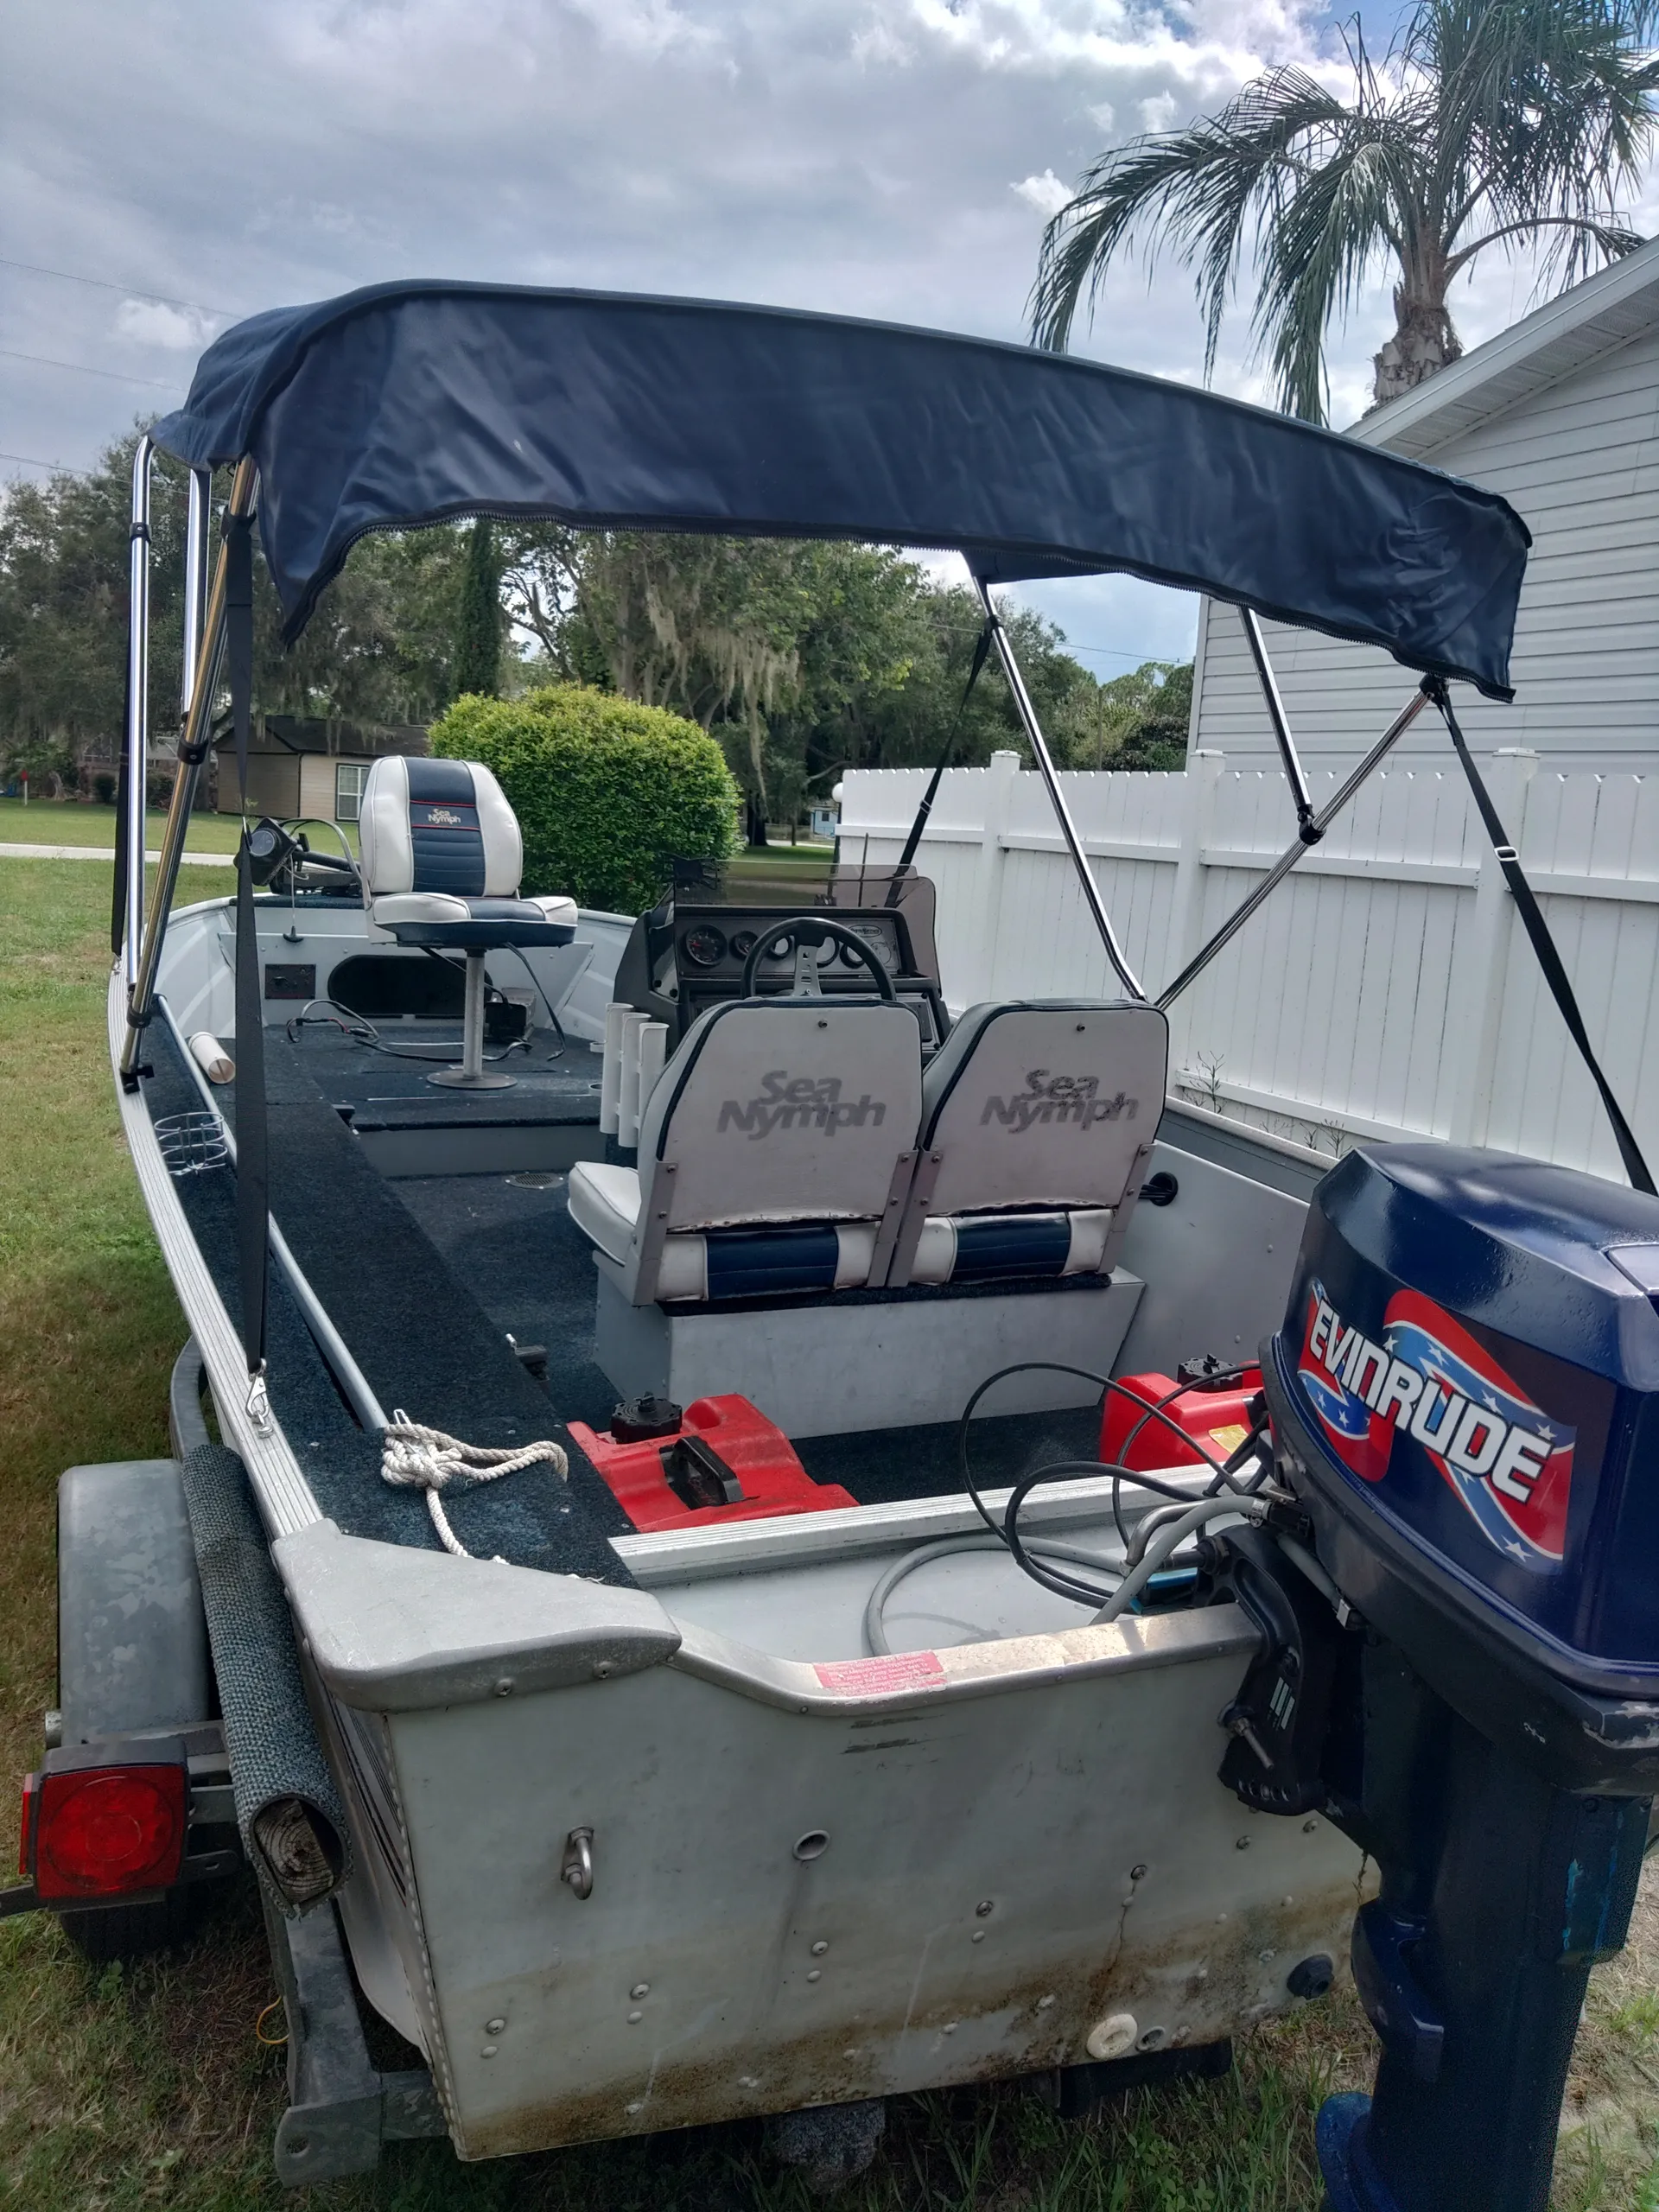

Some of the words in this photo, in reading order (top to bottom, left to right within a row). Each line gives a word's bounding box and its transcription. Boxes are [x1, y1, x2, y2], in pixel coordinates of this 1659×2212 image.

[428, 814, 461, 825] Nymph
[433, 808, 450, 817] Sea
[758, 1070, 842, 1105] Sea
[1025, 1069, 1100, 1101] Sea
[716, 1095, 887, 1141] Nymph
[978, 1091, 1140, 1134] Nymph
[1309, 1300, 1554, 1505] EVINRUDE
